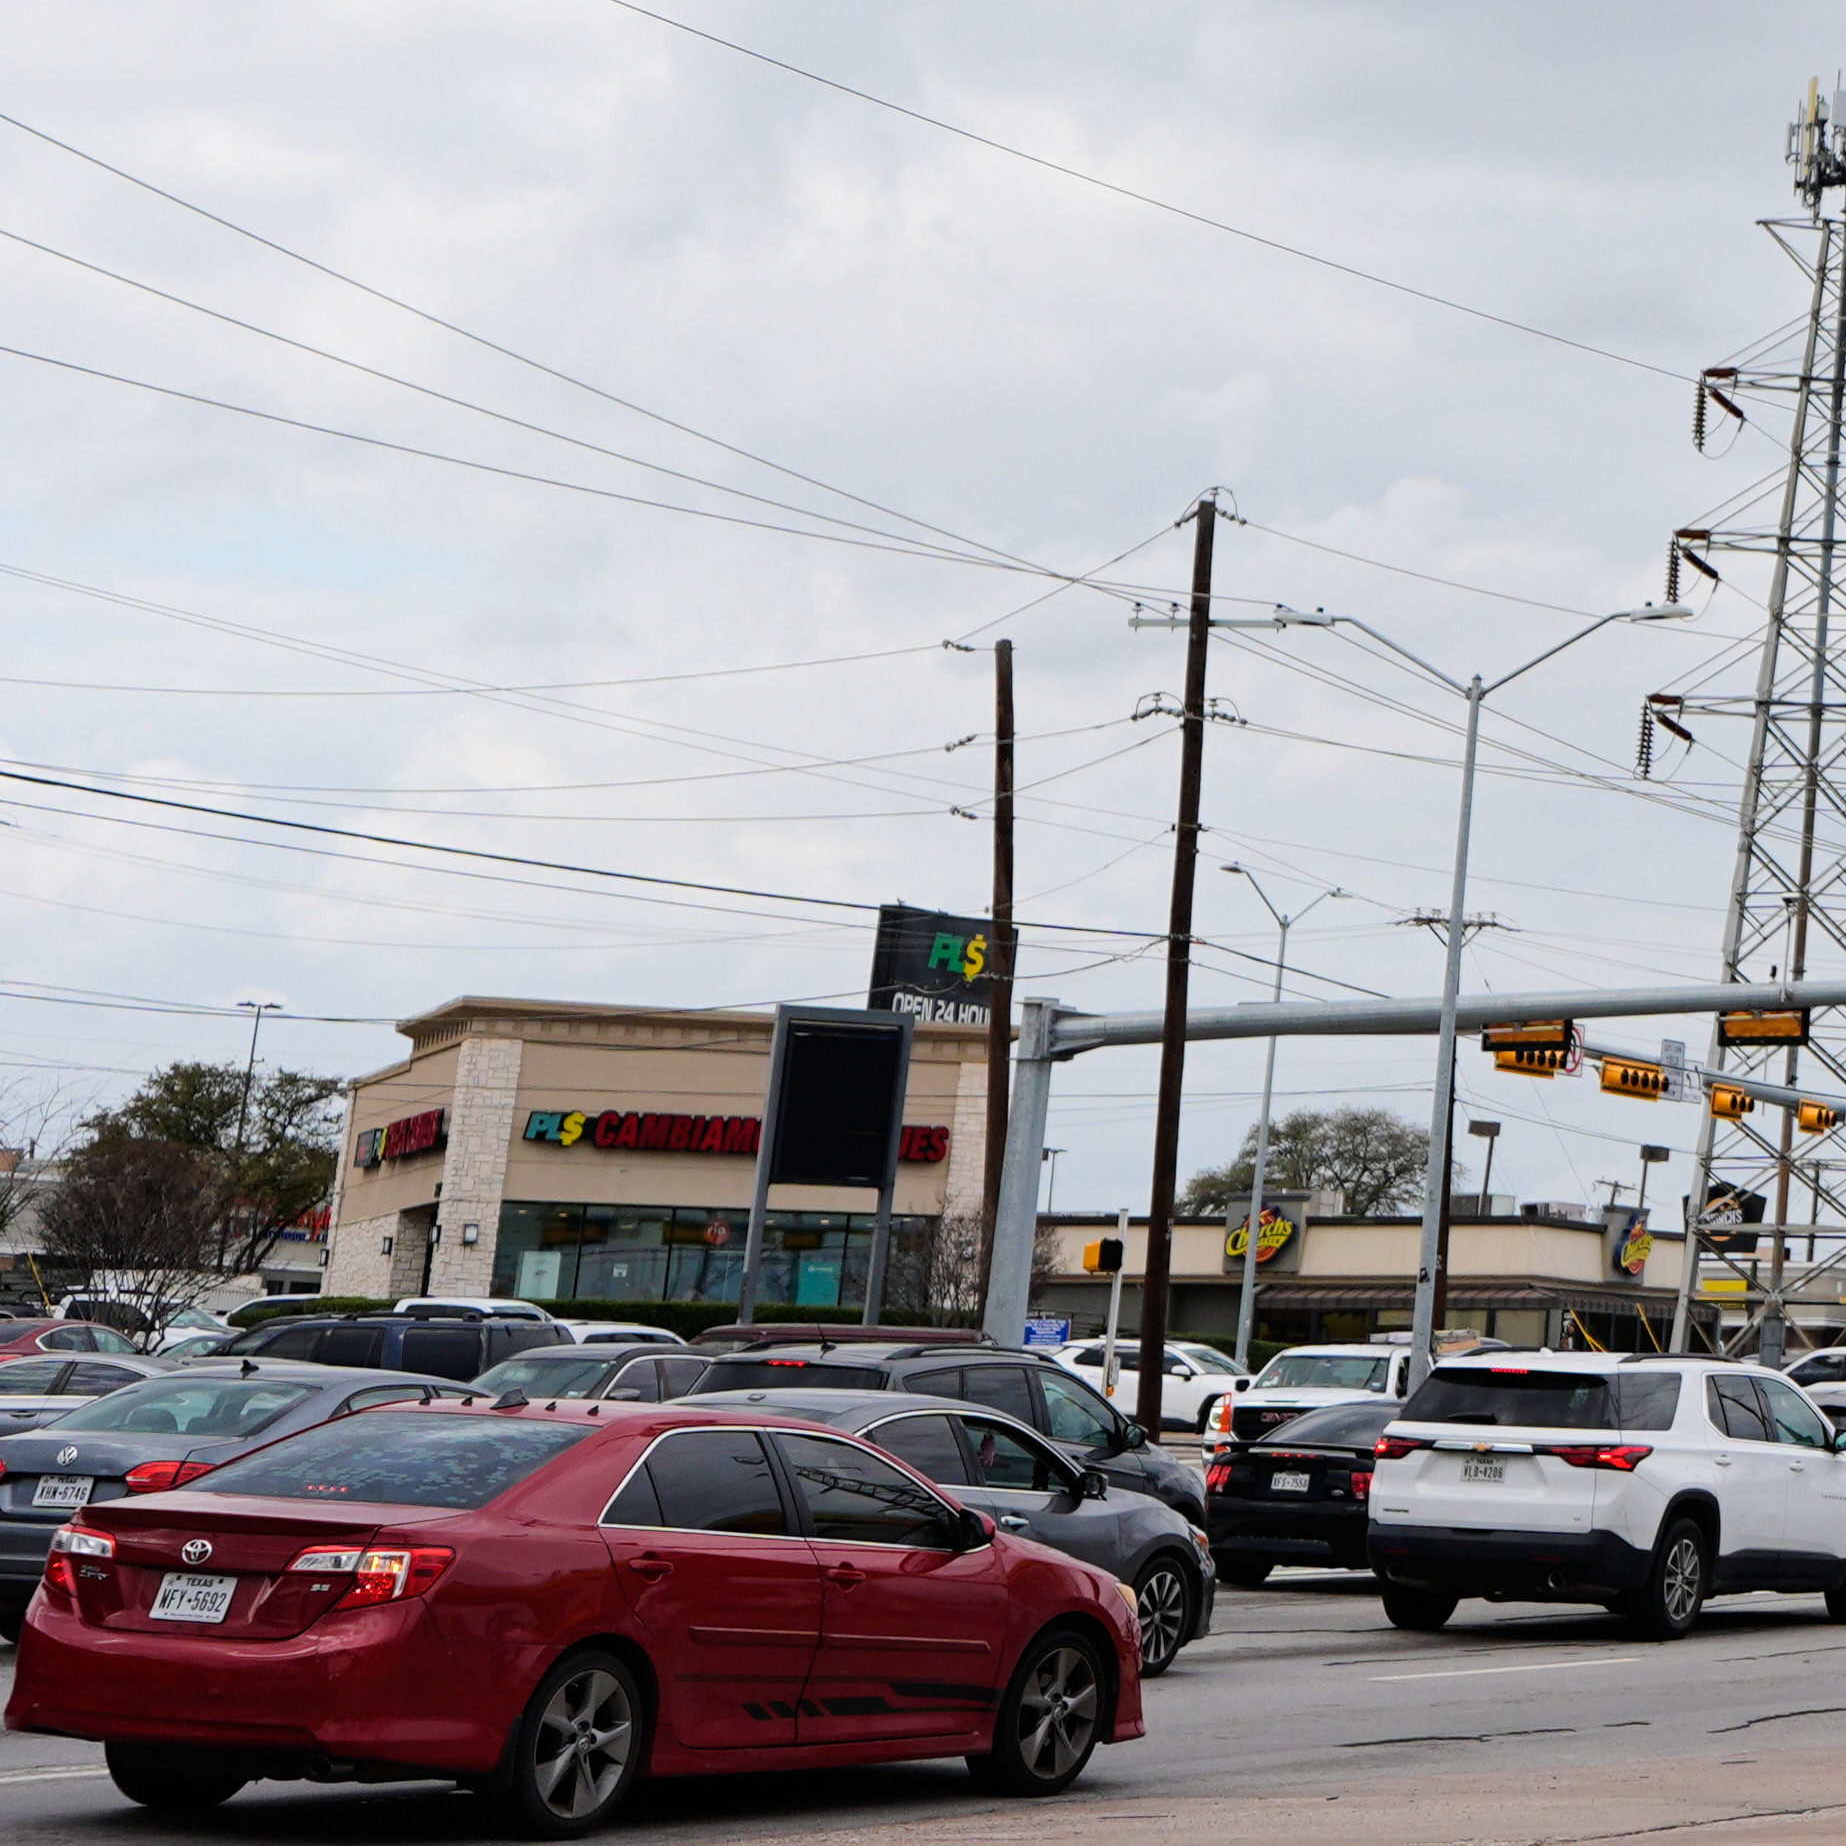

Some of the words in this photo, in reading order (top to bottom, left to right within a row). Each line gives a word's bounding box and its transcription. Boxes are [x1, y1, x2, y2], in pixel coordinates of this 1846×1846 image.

[892, 991, 933, 1022] OPEN
[934, 999, 955, 1023] 24
[957, 1004, 991, 1025] HOU
[593, 1110, 762, 1153] CAMBIAM
[1225, 1216, 1293, 1257] Chrch's
[185, 1576, 215, 1588] TEXAS
